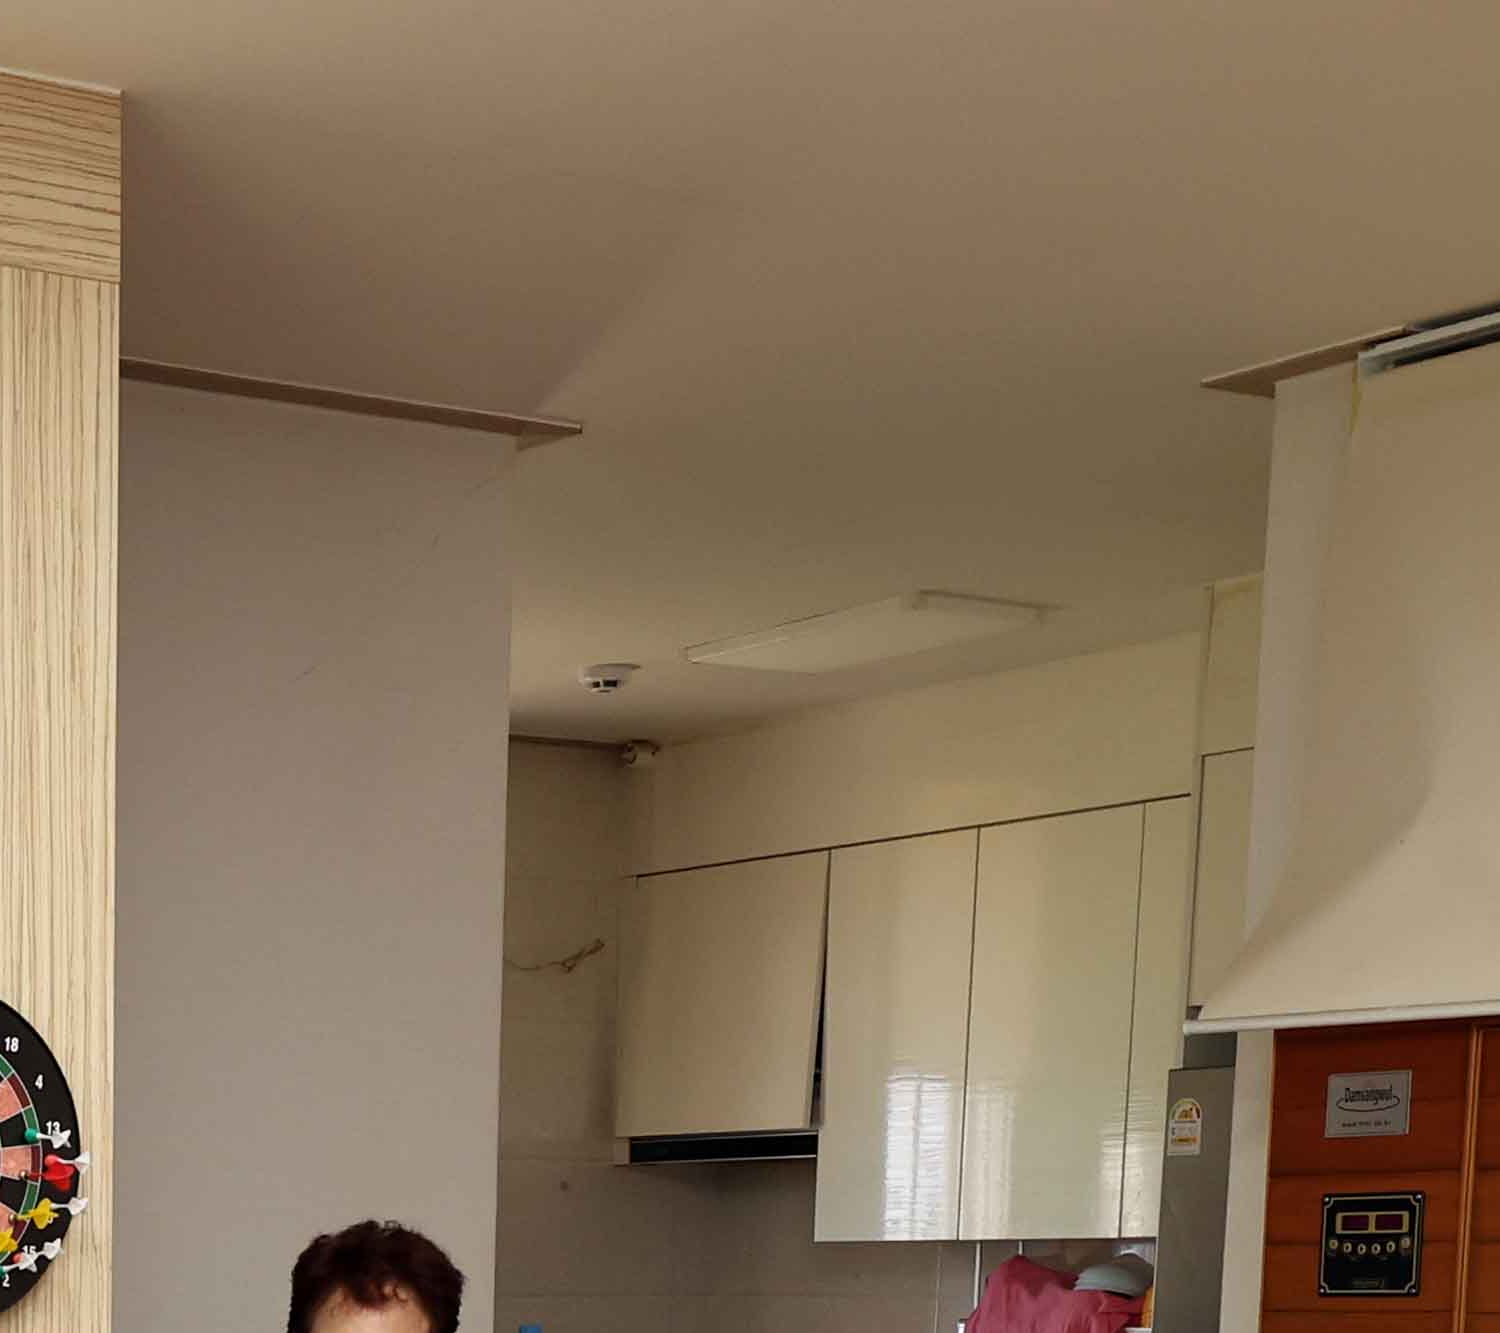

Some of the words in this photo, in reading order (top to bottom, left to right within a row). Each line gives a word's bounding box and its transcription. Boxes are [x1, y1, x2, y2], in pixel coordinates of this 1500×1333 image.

[4, 1037, 19, 1052] 18
[35, 1075, 43, 1090] 4
[46, 1121, 60, 1135] 13
[2, 1274, 10, 1287] 2
